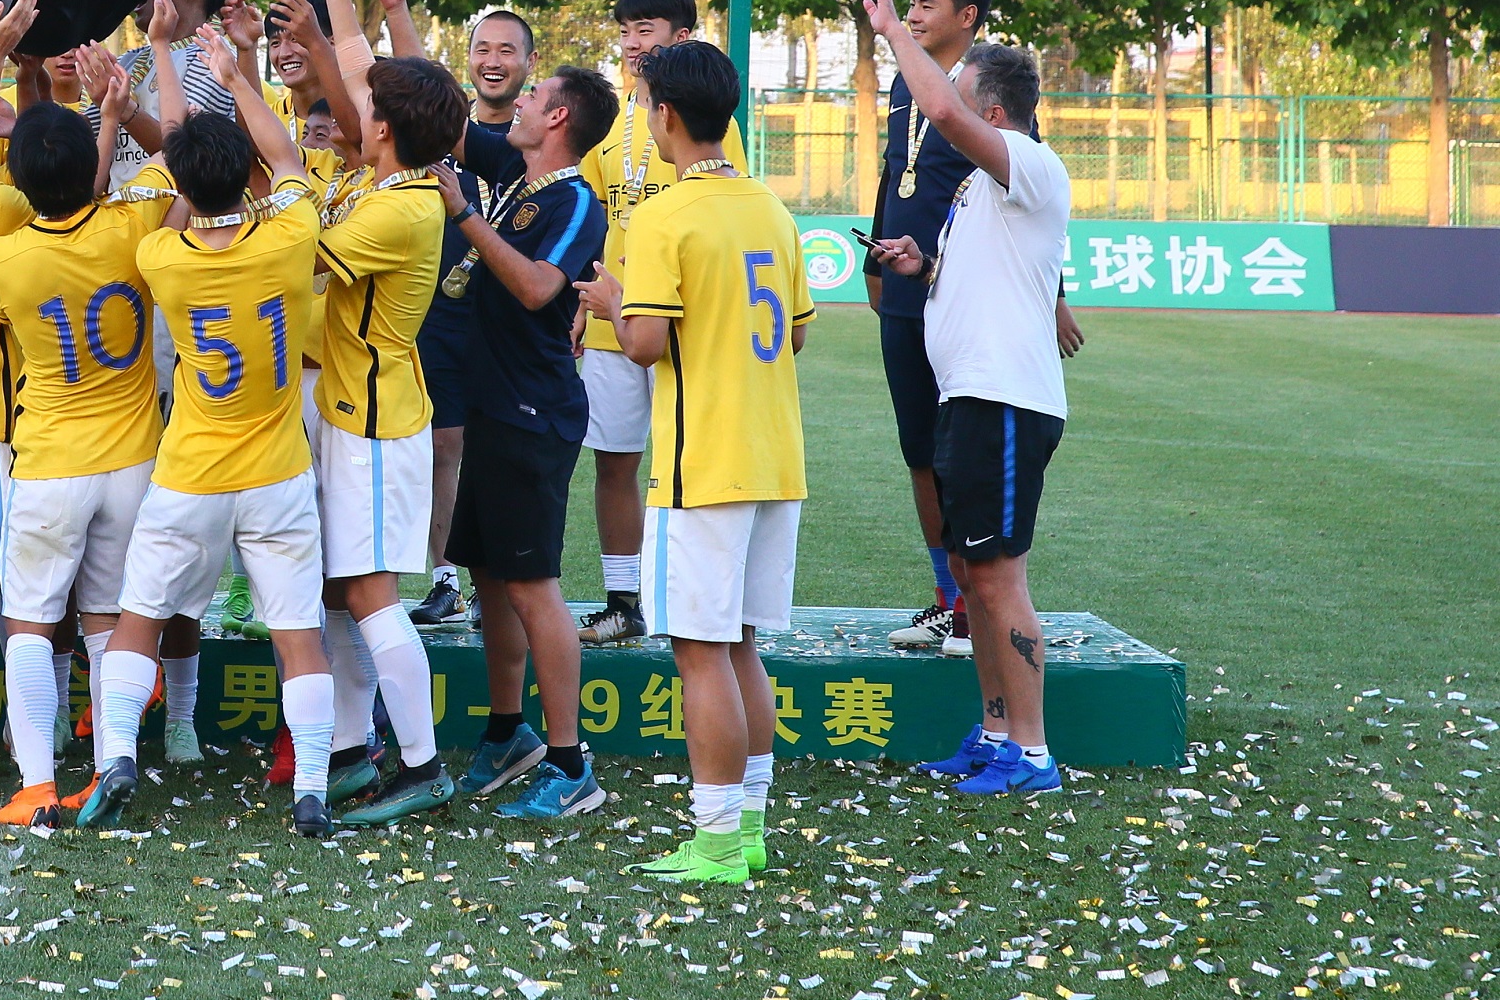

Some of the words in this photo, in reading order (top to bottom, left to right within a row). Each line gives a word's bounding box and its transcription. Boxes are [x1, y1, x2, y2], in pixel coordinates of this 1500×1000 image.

[743, 250, 786, 363] 5
[1062, 236, 1309, 298] 球协会
[38, 281, 146, 384] 10
[188, 295, 289, 399] 51
